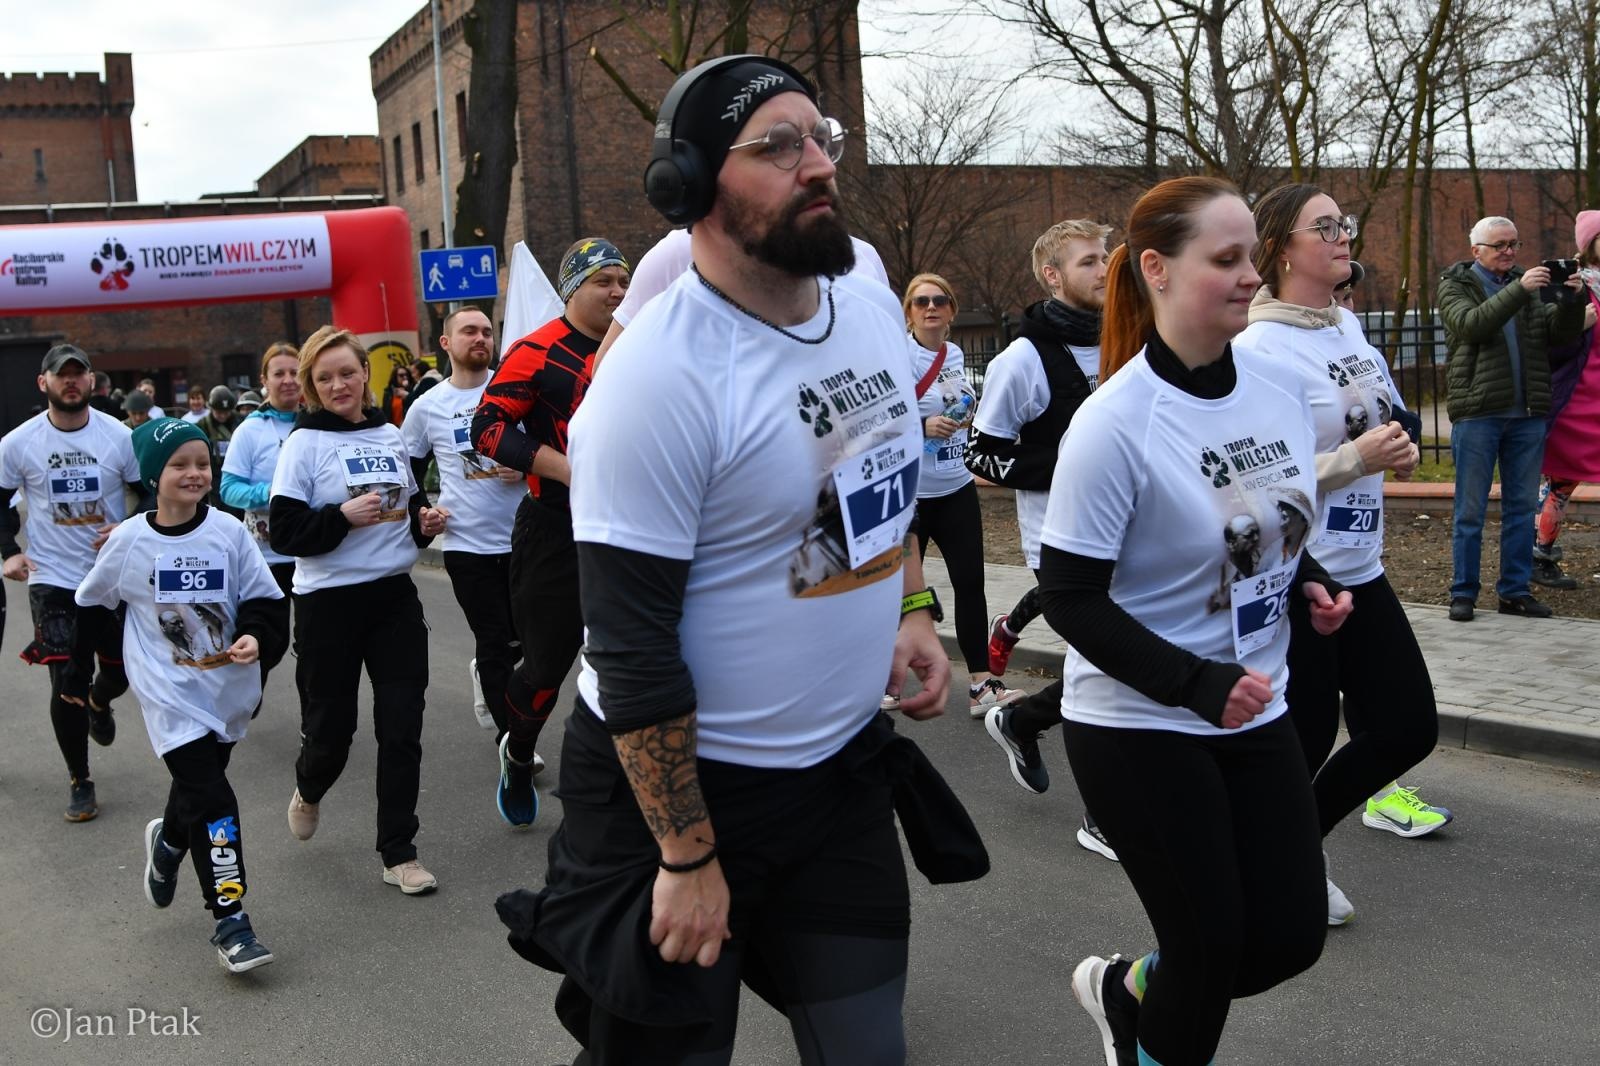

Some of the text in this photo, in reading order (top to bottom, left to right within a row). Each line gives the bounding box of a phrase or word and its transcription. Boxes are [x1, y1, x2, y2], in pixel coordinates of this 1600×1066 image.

[139, 237, 317, 269] TROPEMWILCZYM
[15, 275, 48, 287] Kultury
[820, 368, 857, 393] TROPEM
[829, 369, 897, 415] WILCZYM
[860, 411, 890, 435] EDYCJA
[946, 445, 964, 459] 109
[1223, 436, 1257, 455] TROPEM
[1230, 439, 1291, 473] WILCZYM
[359, 457, 390, 472] 126
[66, 479, 87, 493] 98
[1256, 471, 1285, 488] EDYCJA
[1283, 465, 1301, 479] 2026
[873, 472, 905, 520] 71
[1349, 510, 1373, 531] 20
[180, 571, 207, 590] 96
[1263, 586, 1289, 625] 26
[210, 847, 244, 906] SONIC
